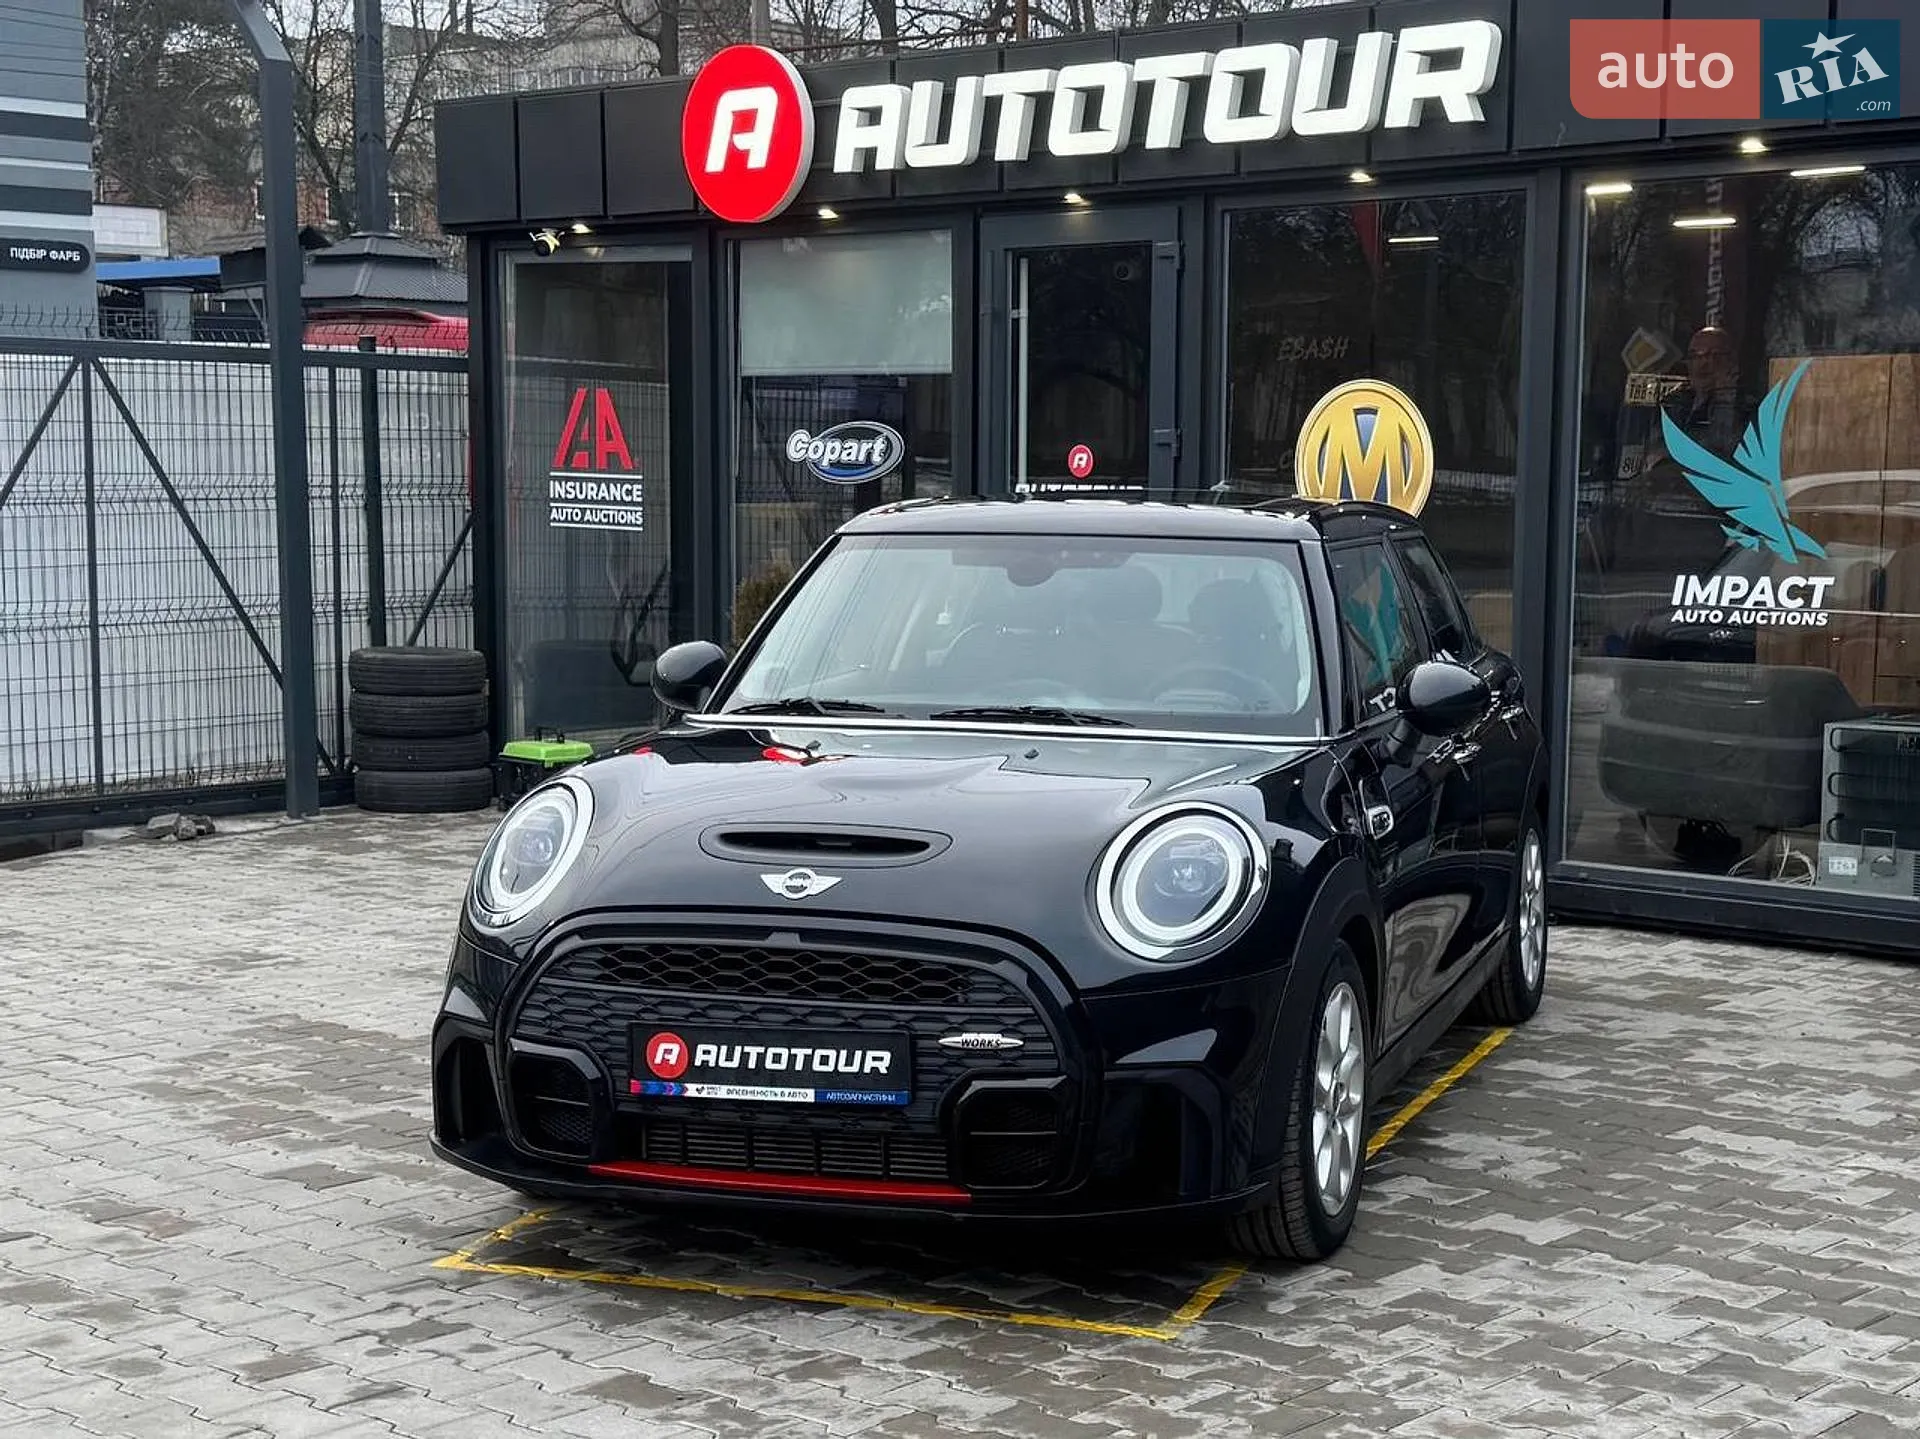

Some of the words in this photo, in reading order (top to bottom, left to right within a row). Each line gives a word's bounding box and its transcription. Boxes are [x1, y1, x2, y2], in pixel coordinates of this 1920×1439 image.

[833, 19, 1503, 174] AUTOTOUR
[10, 247, 47, 261] ПІДБІР
[49, 250, 80, 261] ФАРБ
[786, 429, 889, 468] Copart
[550, 480, 643, 502] INSURANCE
[551, 507, 581, 521] AUTO
[584, 509, 643, 525] AUCTIONS
[1671, 574, 1835, 609] IMPACT
[1671, 608, 1723, 624] AUTO
[1727, 610, 1829, 626] AUCTIONS
[961, 1038, 1001, 1047] WORKS
[694, 1044, 892, 1075] AUTOTOUR
